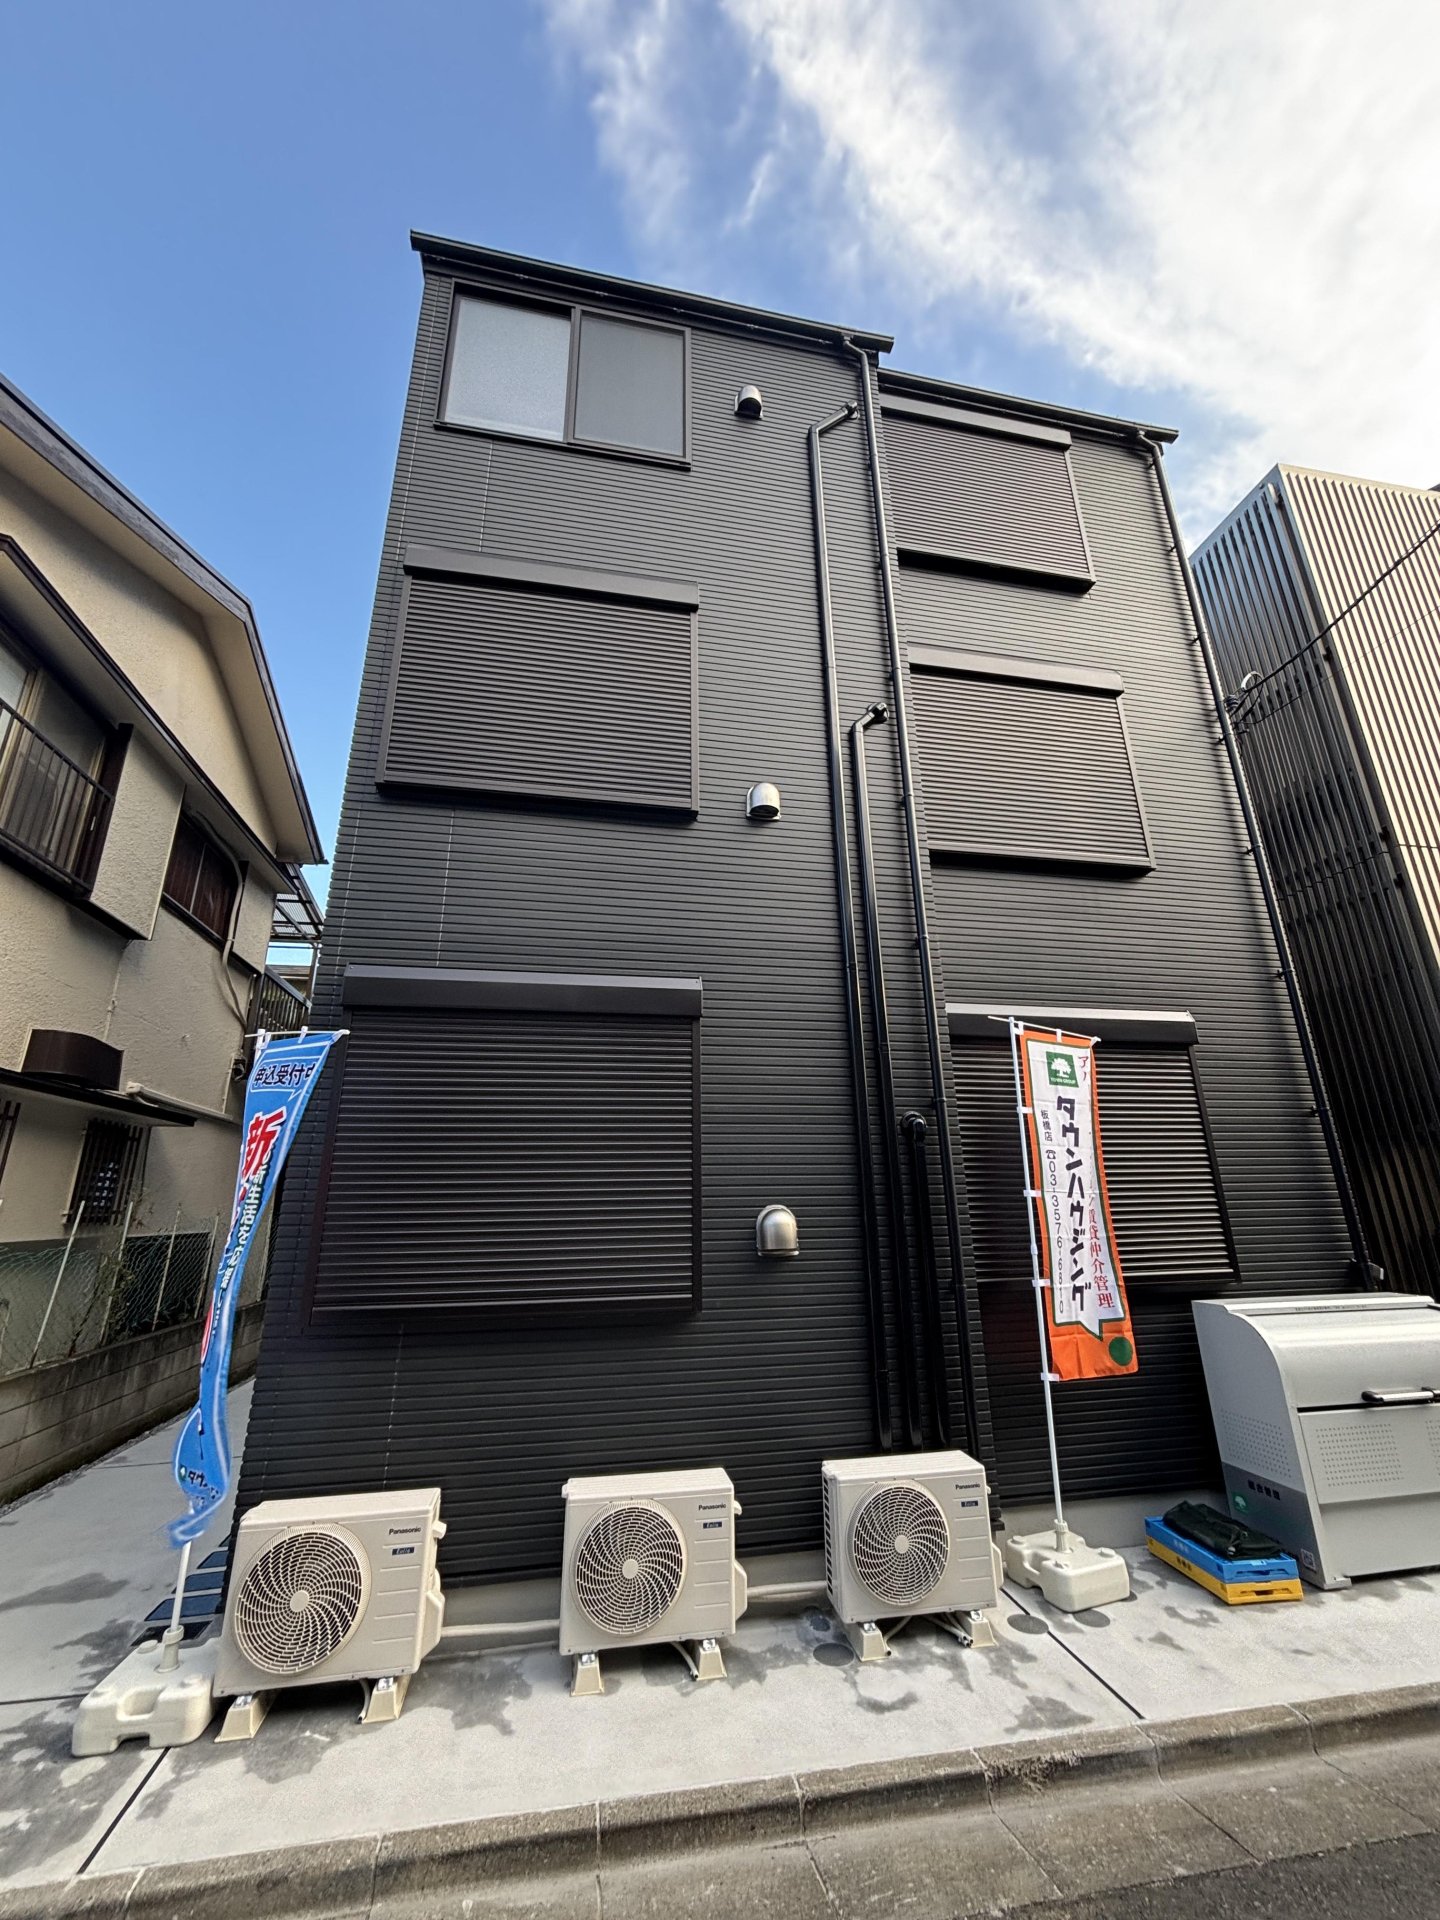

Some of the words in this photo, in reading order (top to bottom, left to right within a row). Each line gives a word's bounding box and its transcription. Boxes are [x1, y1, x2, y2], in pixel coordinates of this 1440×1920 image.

[1041, 1109, 1053, 1142] 板橋店
[1056, 1095, 1091, 1312] タウンハウジング
[698, 1502, 727, 1511] Panasonic
[388, 1526, 421, 1535] Panasonic
